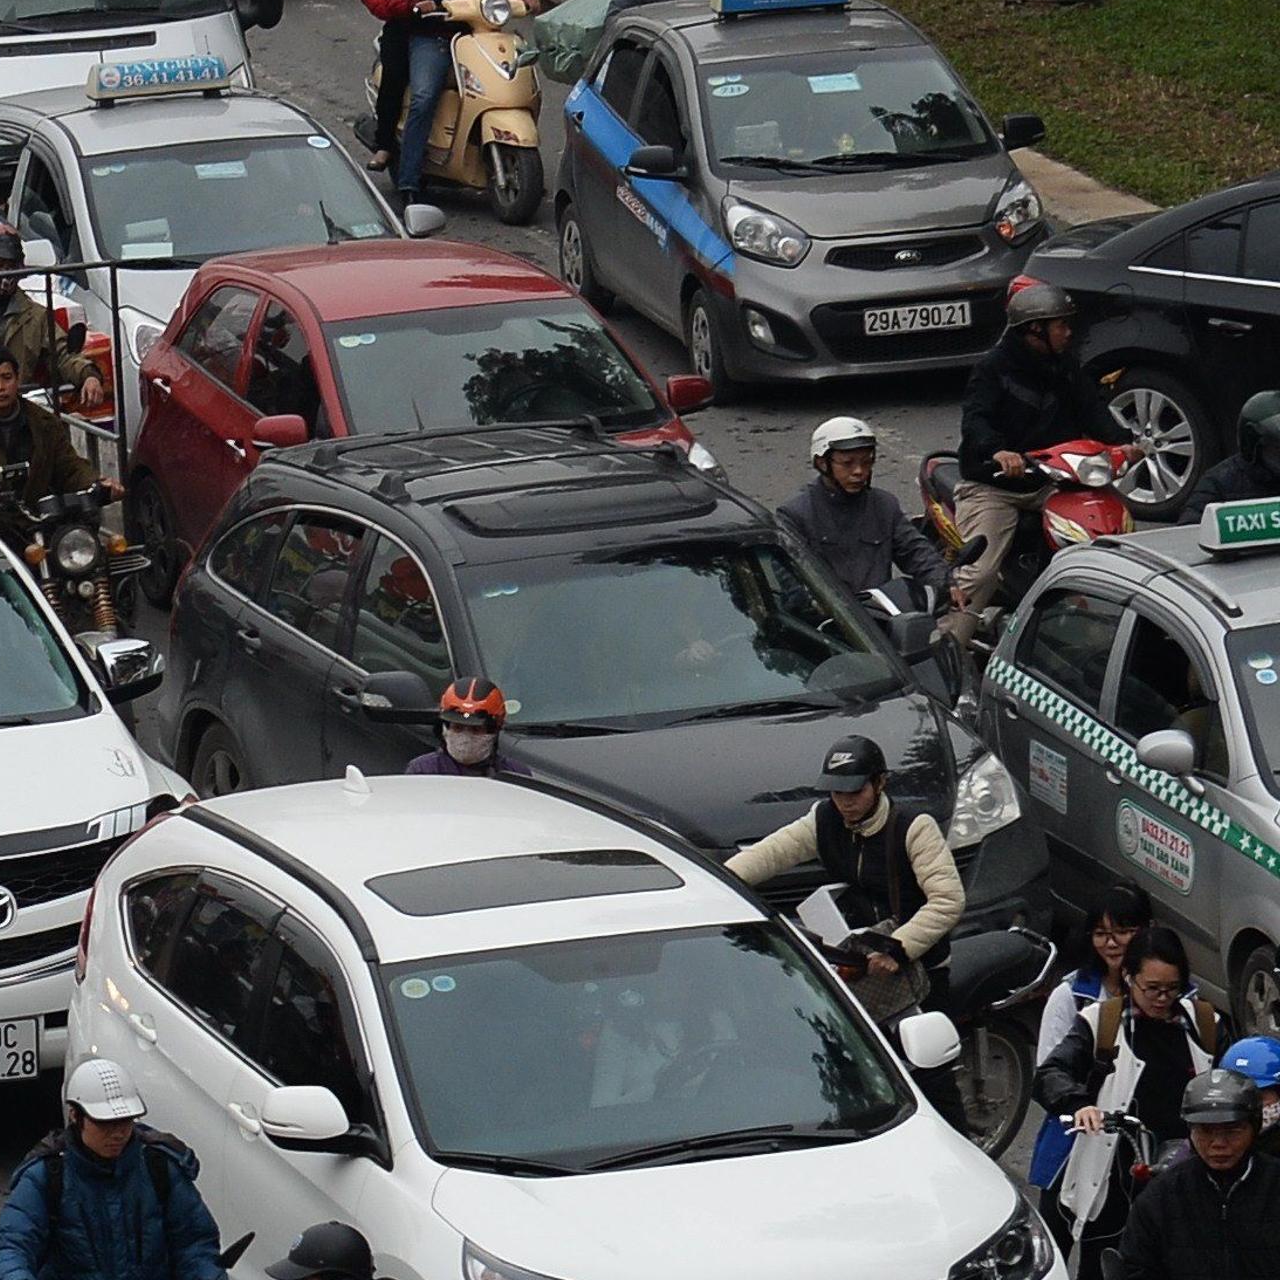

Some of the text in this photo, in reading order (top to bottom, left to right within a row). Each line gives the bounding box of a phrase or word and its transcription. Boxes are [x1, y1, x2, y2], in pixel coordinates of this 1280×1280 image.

[122, 60, 160, 75] TAXI
[122, 67, 220, 89] 36.41.41.41
[866, 303, 970, 334] 29A-790.21
[1224, 512, 1268, 534] TAXI
